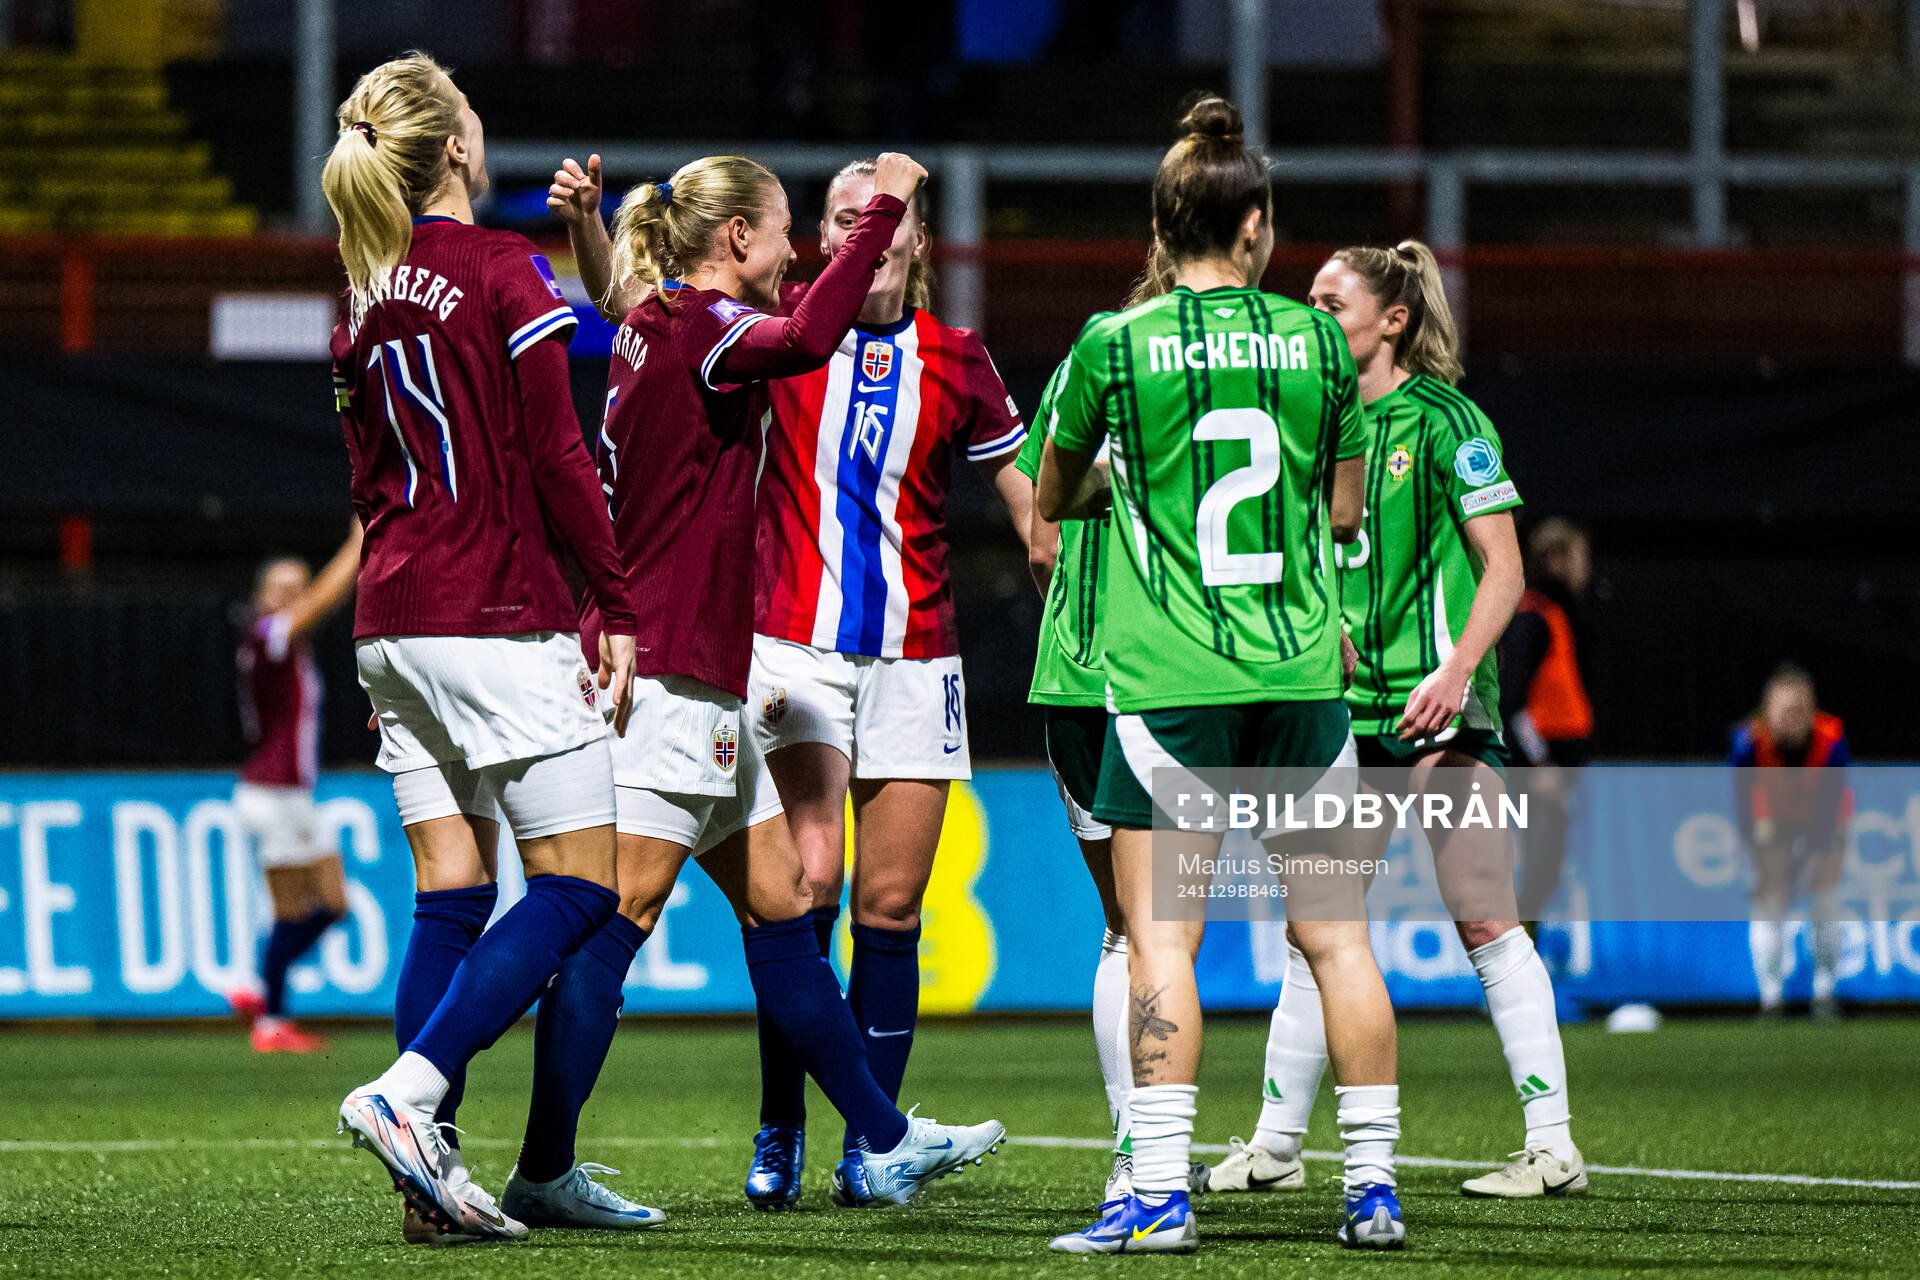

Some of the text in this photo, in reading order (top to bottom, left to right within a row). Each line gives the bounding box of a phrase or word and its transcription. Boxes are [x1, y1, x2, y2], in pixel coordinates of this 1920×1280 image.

[367, 333, 457, 508] 14
[848, 400, 889, 465] 16
[1193, 407, 1283, 586] 2
[942, 674, 961, 732] 16
[114, 797, 387, 996] DOS
